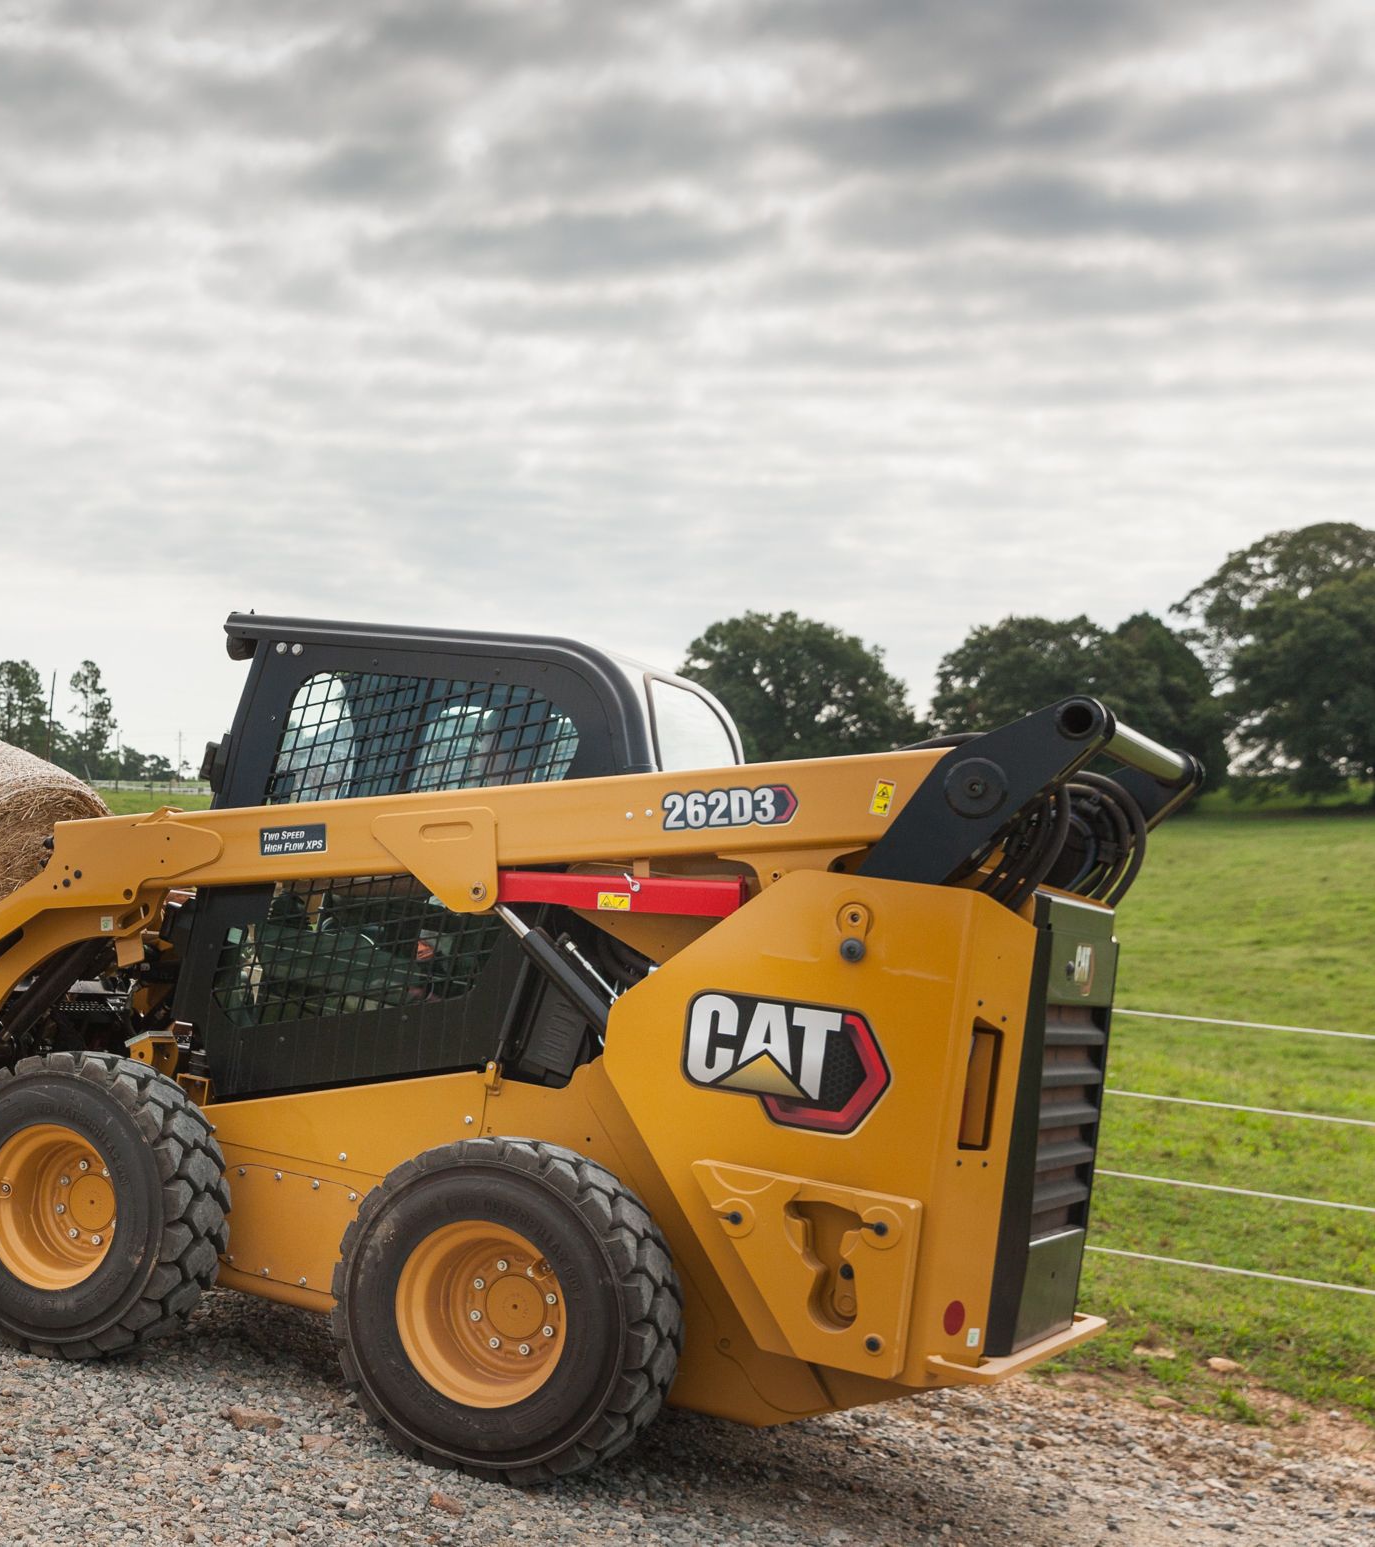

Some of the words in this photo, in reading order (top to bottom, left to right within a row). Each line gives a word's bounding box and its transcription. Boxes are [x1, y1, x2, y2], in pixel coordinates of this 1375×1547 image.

[663, 787, 776, 829] 262D3
[306, 839, 324, 850] XPS
[687, 994, 843, 1100] CAT
